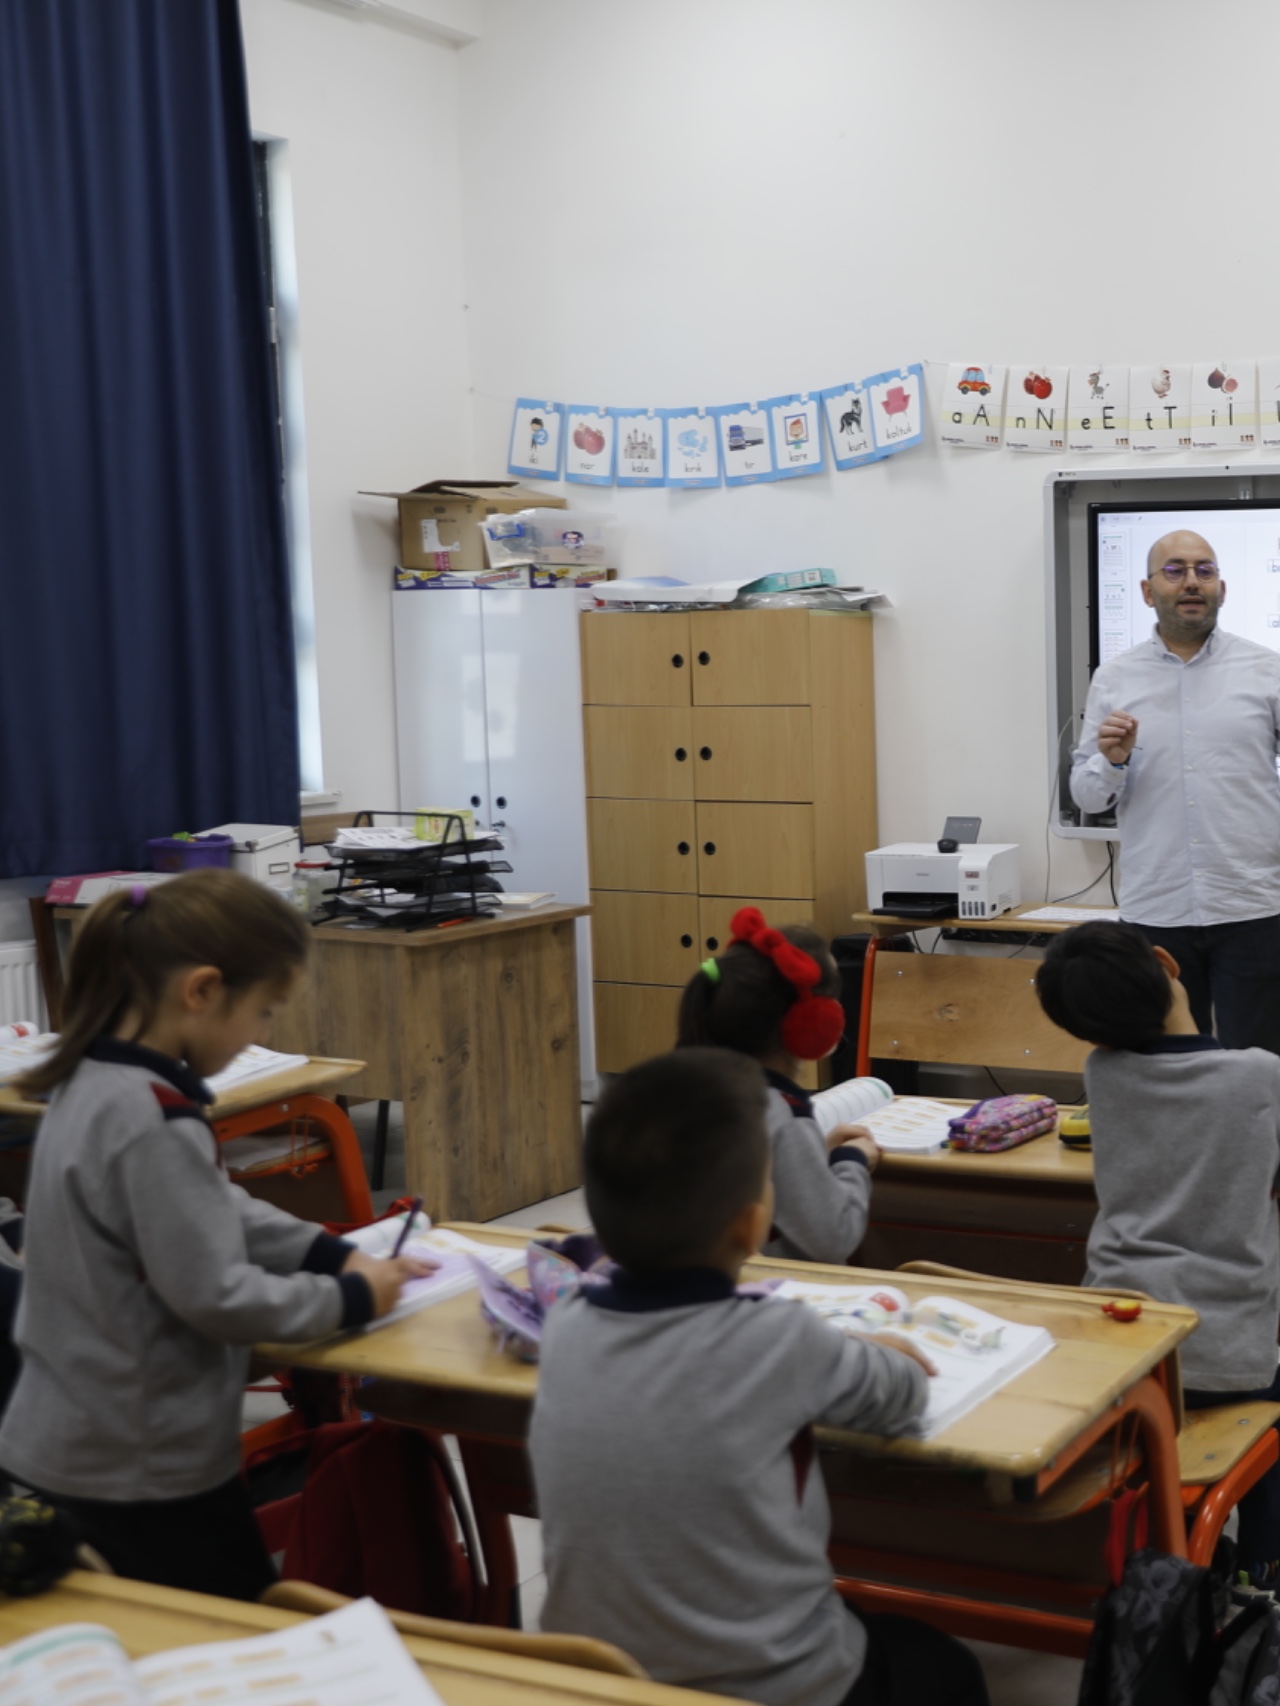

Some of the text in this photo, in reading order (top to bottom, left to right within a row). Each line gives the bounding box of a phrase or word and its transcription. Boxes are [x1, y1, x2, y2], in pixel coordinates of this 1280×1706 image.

[952, 404, 990, 426] a A
[1016, 408, 1053, 430] n N
[1082, 406, 1115, 430] e E
[1145, 406, 1177, 430] t T
[886, 424, 912, 440] koltuk
[848, 440, 867, 452] kurt
[789, 451, 808, 463] kare
[631, 461, 650, 473] kale
